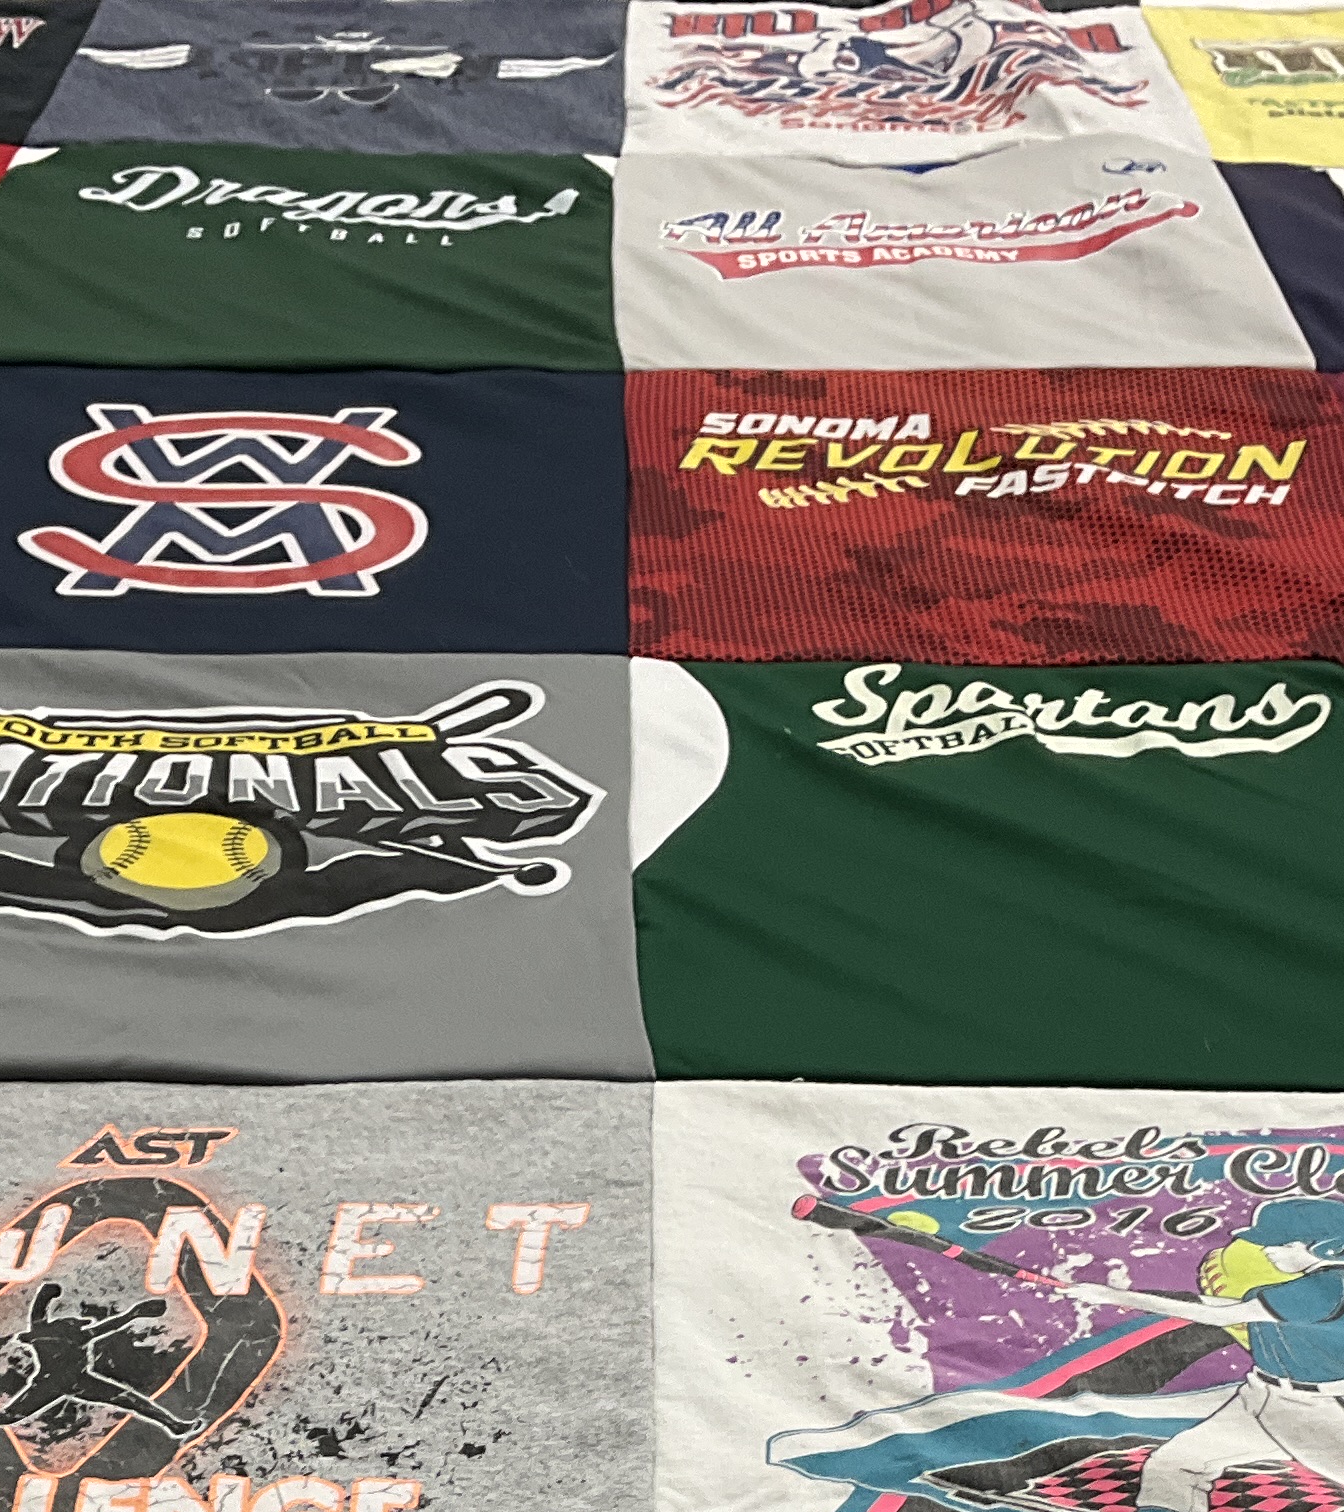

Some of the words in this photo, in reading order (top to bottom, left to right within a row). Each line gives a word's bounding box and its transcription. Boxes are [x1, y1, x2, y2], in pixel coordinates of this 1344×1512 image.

[78, 164, 546, 228] Dragons
[662, 209, 783, 246] All
[803, 186, 1156, 247] American
[736, 246, 862, 270] SPORTS
[872, 245, 1020, 265] ACADEMY
[698, 411, 931, 441] SONOMA
[678, 428, 1307, 482] REVOLUTION
[955, 462, 1289, 505] FASTPITCH
[813, 662, 1316, 735] Spartans
[160, 726, 429, 750] SOFTBALL
[833, 716, 1029, 759] OFTBAL
[59, 1123, 238, 1170] AST
[878, 1120, 1211, 1163] Rebels
[819, 1146, 1203, 1201] Summer
[959, 1205, 1226, 1237] 2016
